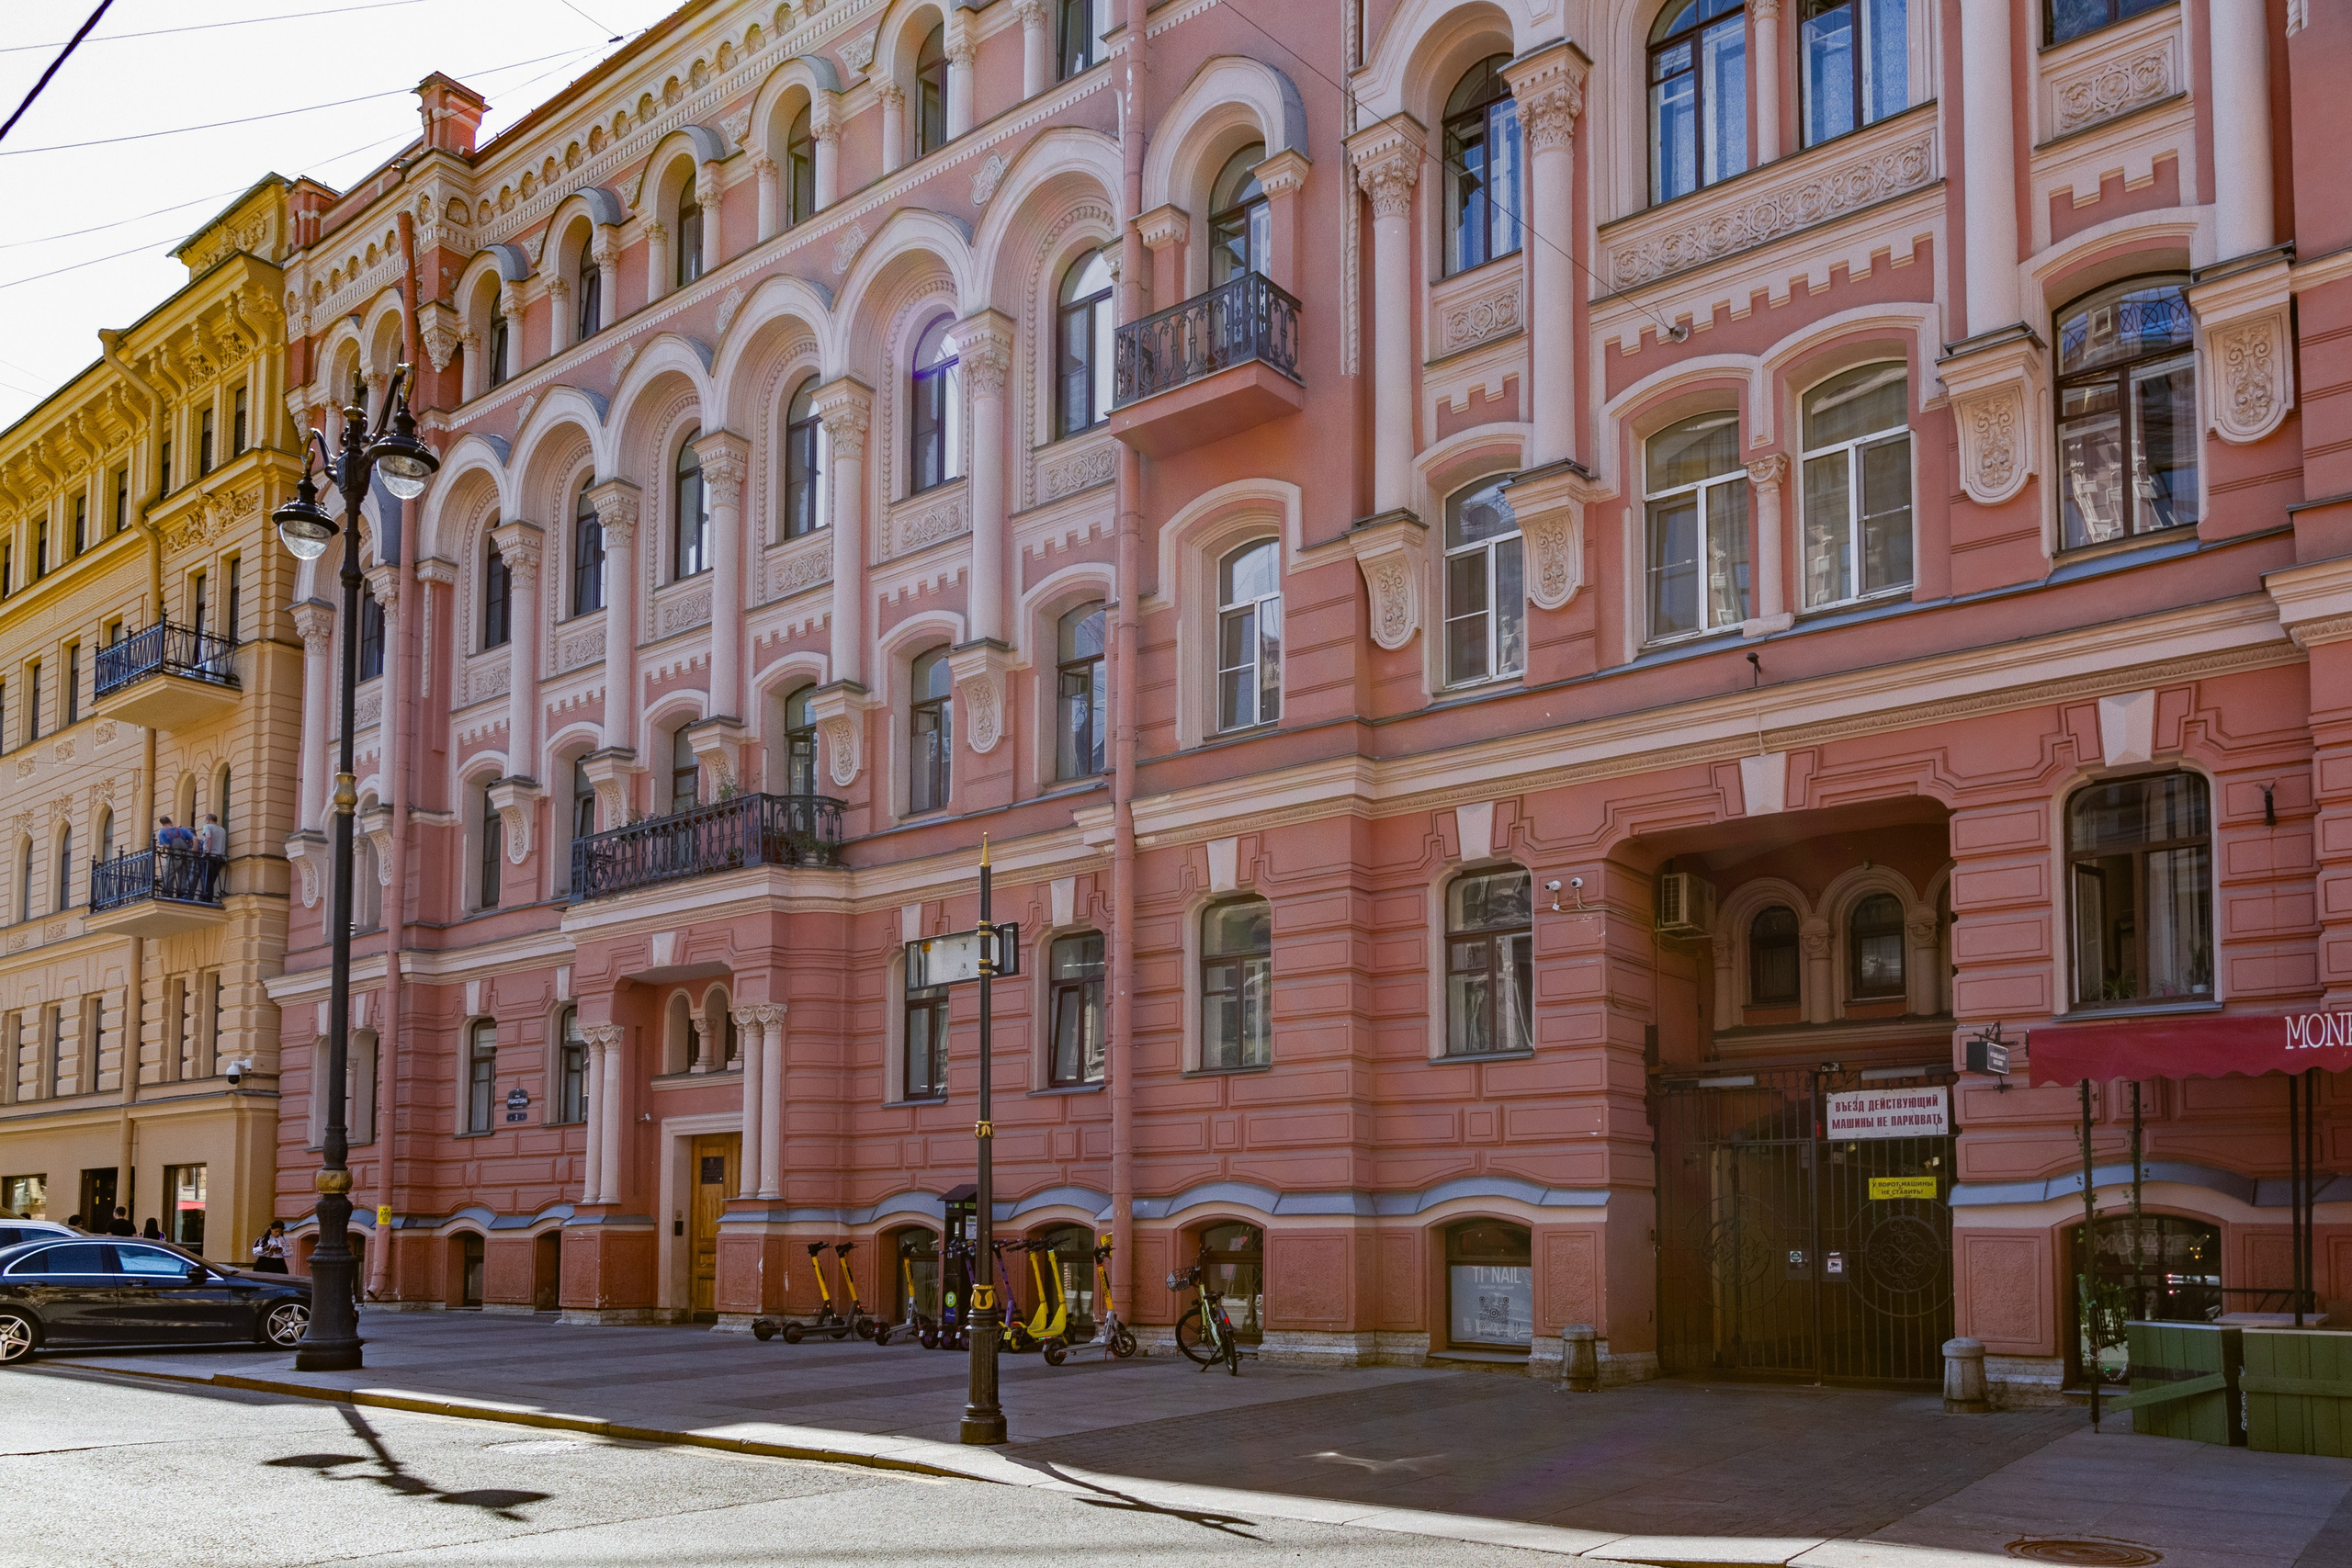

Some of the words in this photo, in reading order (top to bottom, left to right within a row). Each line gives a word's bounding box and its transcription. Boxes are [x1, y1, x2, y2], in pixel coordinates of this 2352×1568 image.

[1835, 1100, 1864, 1112] ВЪЕЗД
[1869, 1094, 1939, 1112] ДЕЙСТВУЮЩИЙ
[1832, 1117, 1873, 1129] МАШИНЫ
[1877, 1116, 1887, 1127] НЕ
[1891, 1113, 1943, 1126] ПАРКОВАТЬ
[1491, 1267, 1521, 1283] NAIL
[947, 1293, 955, 1304] P
